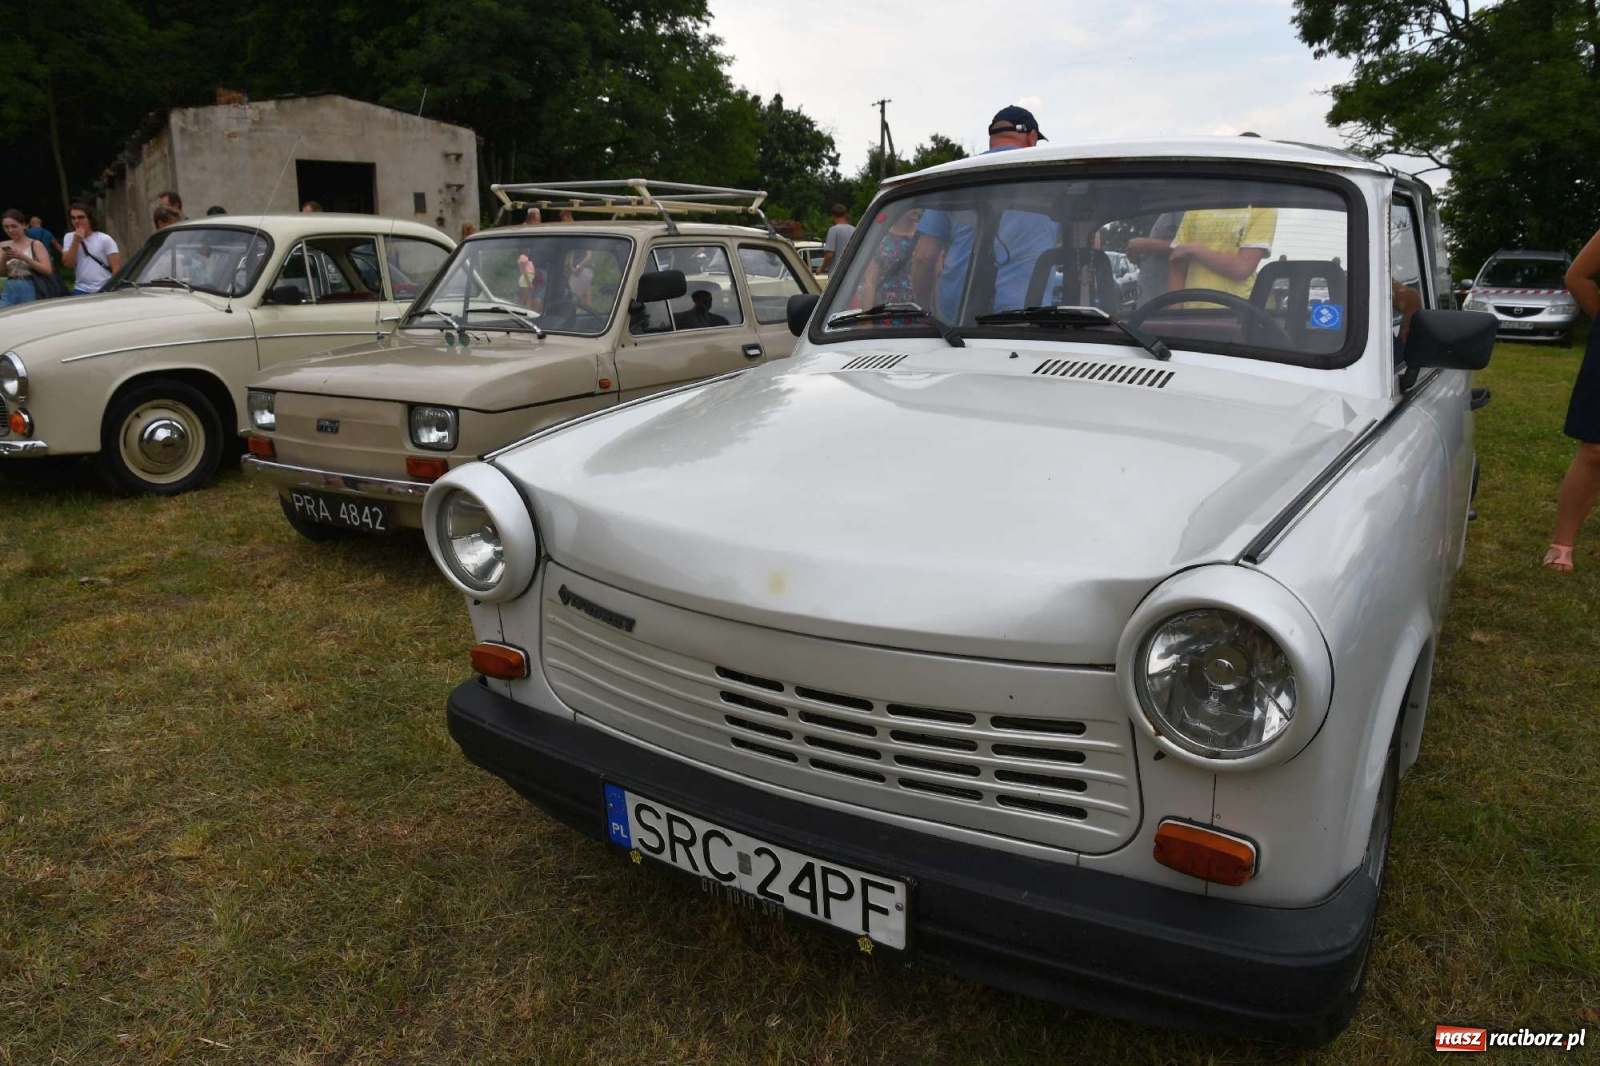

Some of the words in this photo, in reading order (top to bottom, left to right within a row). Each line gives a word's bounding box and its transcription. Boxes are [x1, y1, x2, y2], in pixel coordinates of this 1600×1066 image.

[292, 493, 332, 521] PRA
[340, 502, 385, 530] 4842
[611, 822, 628, 839] PL
[634, 802, 737, 882] SRC
[753, 846, 895, 933] 24PF
